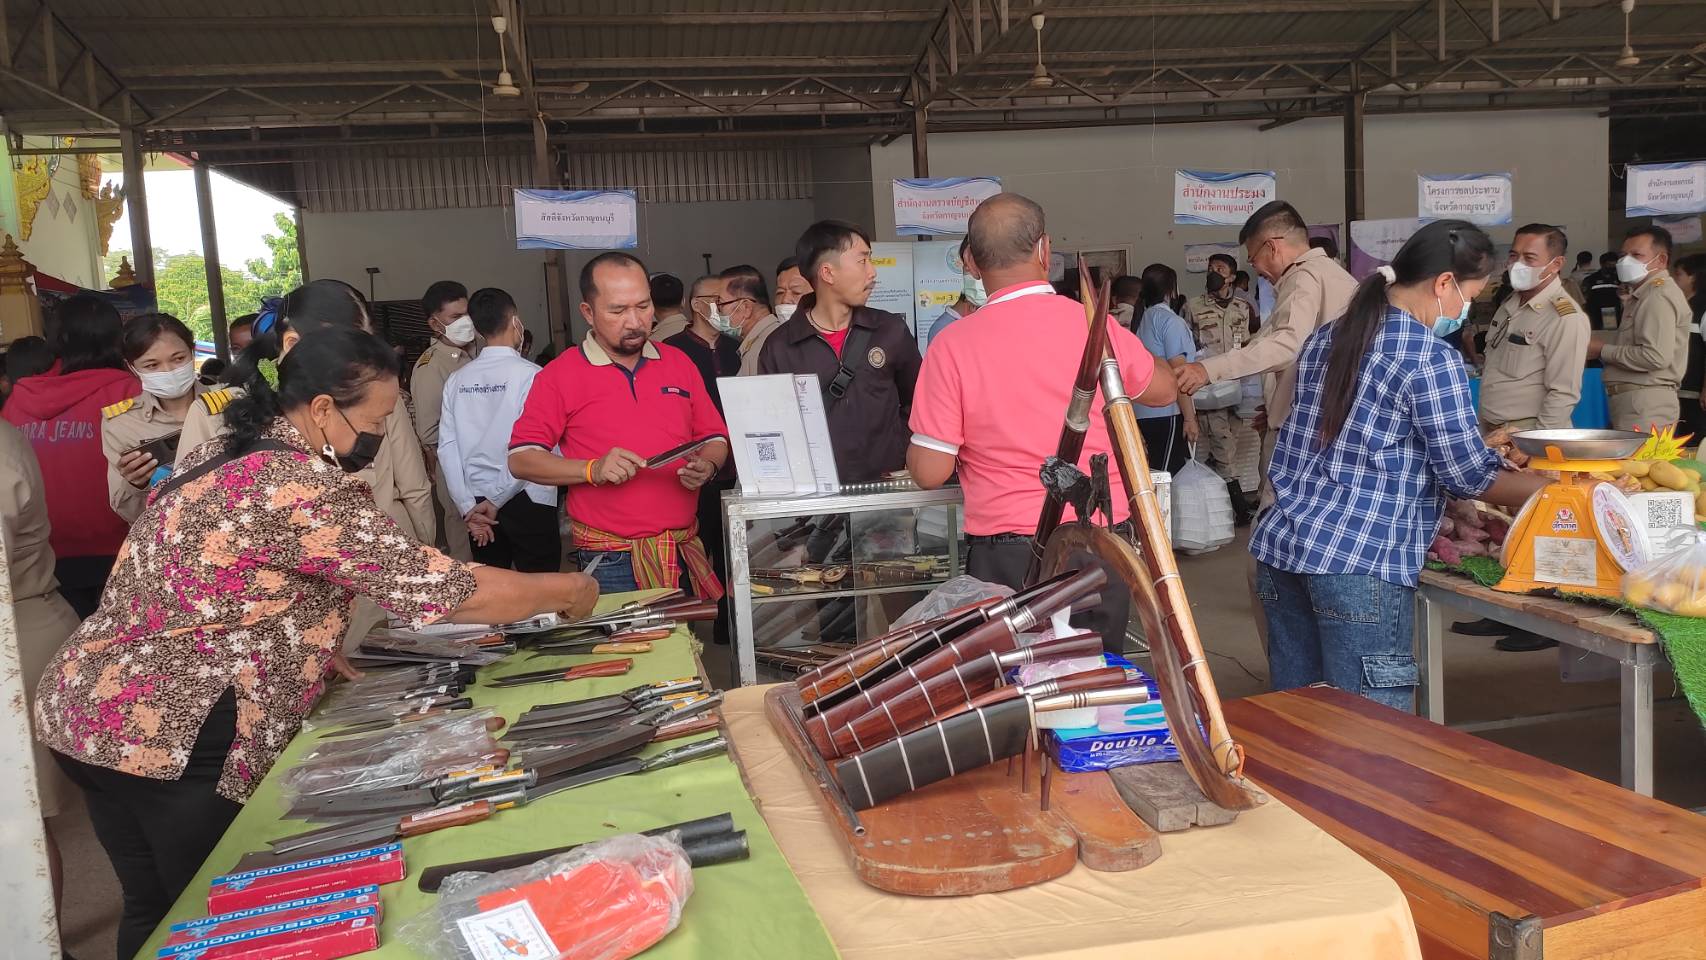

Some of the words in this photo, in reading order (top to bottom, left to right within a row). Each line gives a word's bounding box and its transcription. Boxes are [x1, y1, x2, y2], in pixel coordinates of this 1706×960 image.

[1183, 184, 1266, 199] สำนักงานประมง
[1428, 185, 1501, 196] โครงการชลประทาน
[1193, 201, 1254, 214] จังหวัดกาญจนบุรี
[1434, 200, 1496, 214] จังหวัดกาญจนบุรี
[49, 420, 94, 442] JEANS
[1090, 735, 1157, 752] Double
[225, 850, 372, 881] CARBORUNDUM
[186, 892, 346, 927] CARBORUNDUM
[174, 914, 340, 952] CARBORUNDUM
